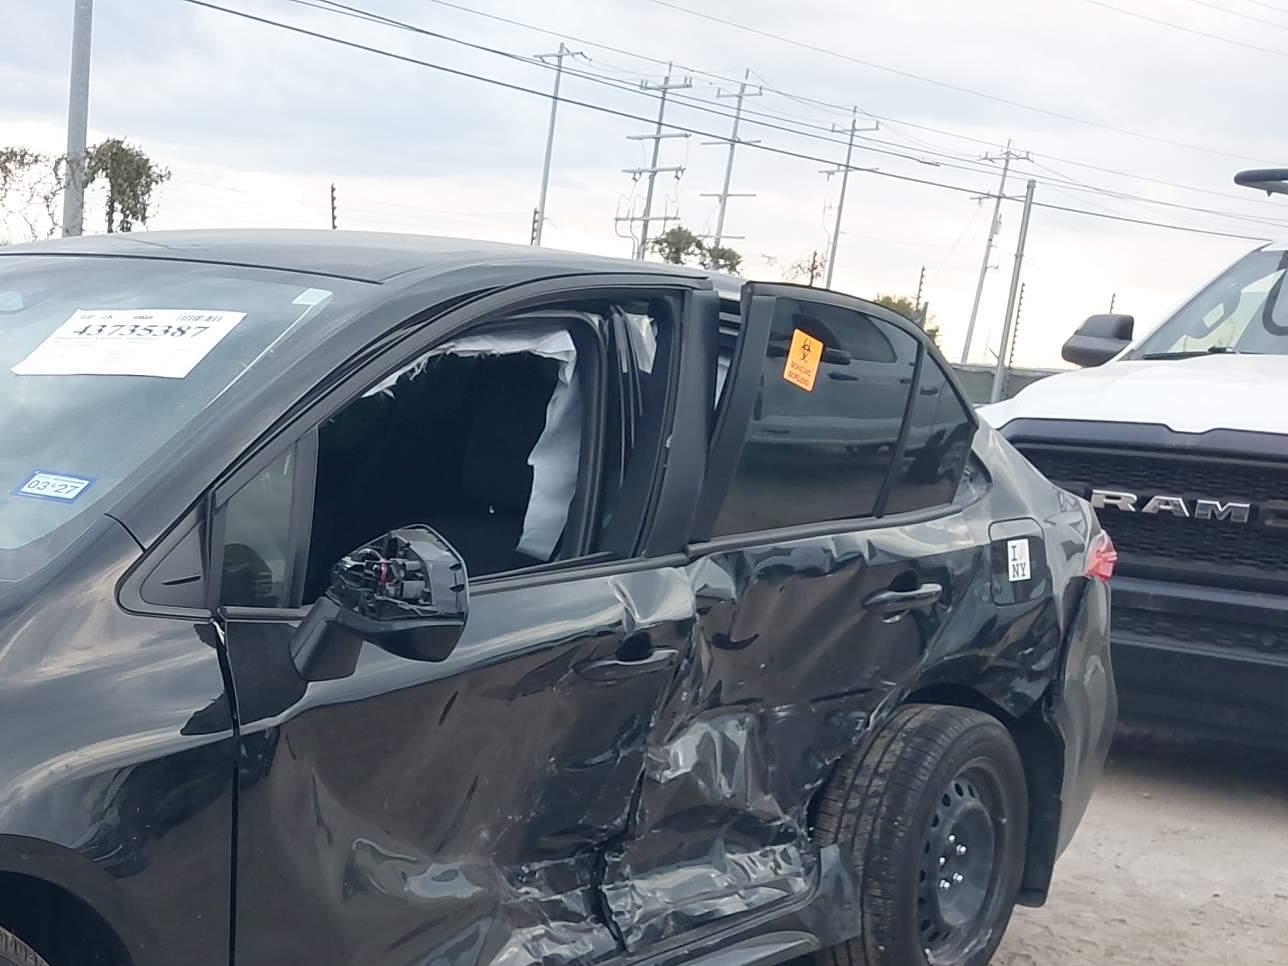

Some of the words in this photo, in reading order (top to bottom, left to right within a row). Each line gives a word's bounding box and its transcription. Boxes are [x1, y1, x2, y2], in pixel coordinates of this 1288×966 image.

[73, 324, 210, 338] 43735387
[1090, 489, 1251, 524] RAM
[1012, 562, 1026, 578] NY
